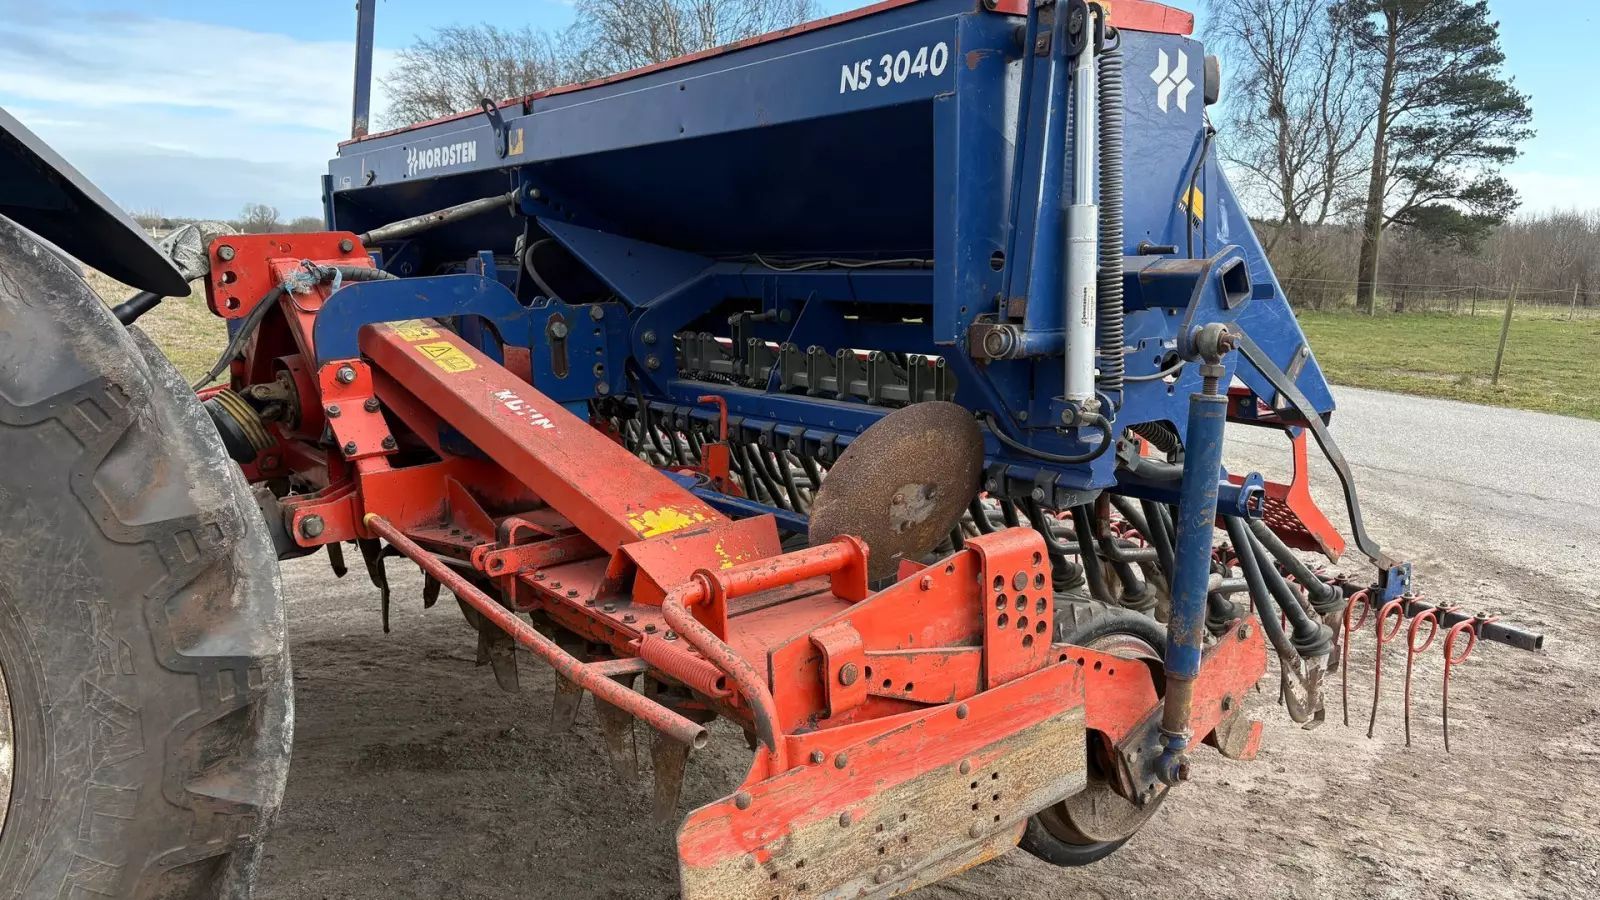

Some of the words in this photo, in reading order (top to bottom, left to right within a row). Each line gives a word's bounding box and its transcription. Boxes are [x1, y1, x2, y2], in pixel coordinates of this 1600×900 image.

[839, 58, 872, 94] NS
[877, 41, 949, 87] 3040
[418, 140, 477, 170] NORDSTEN
